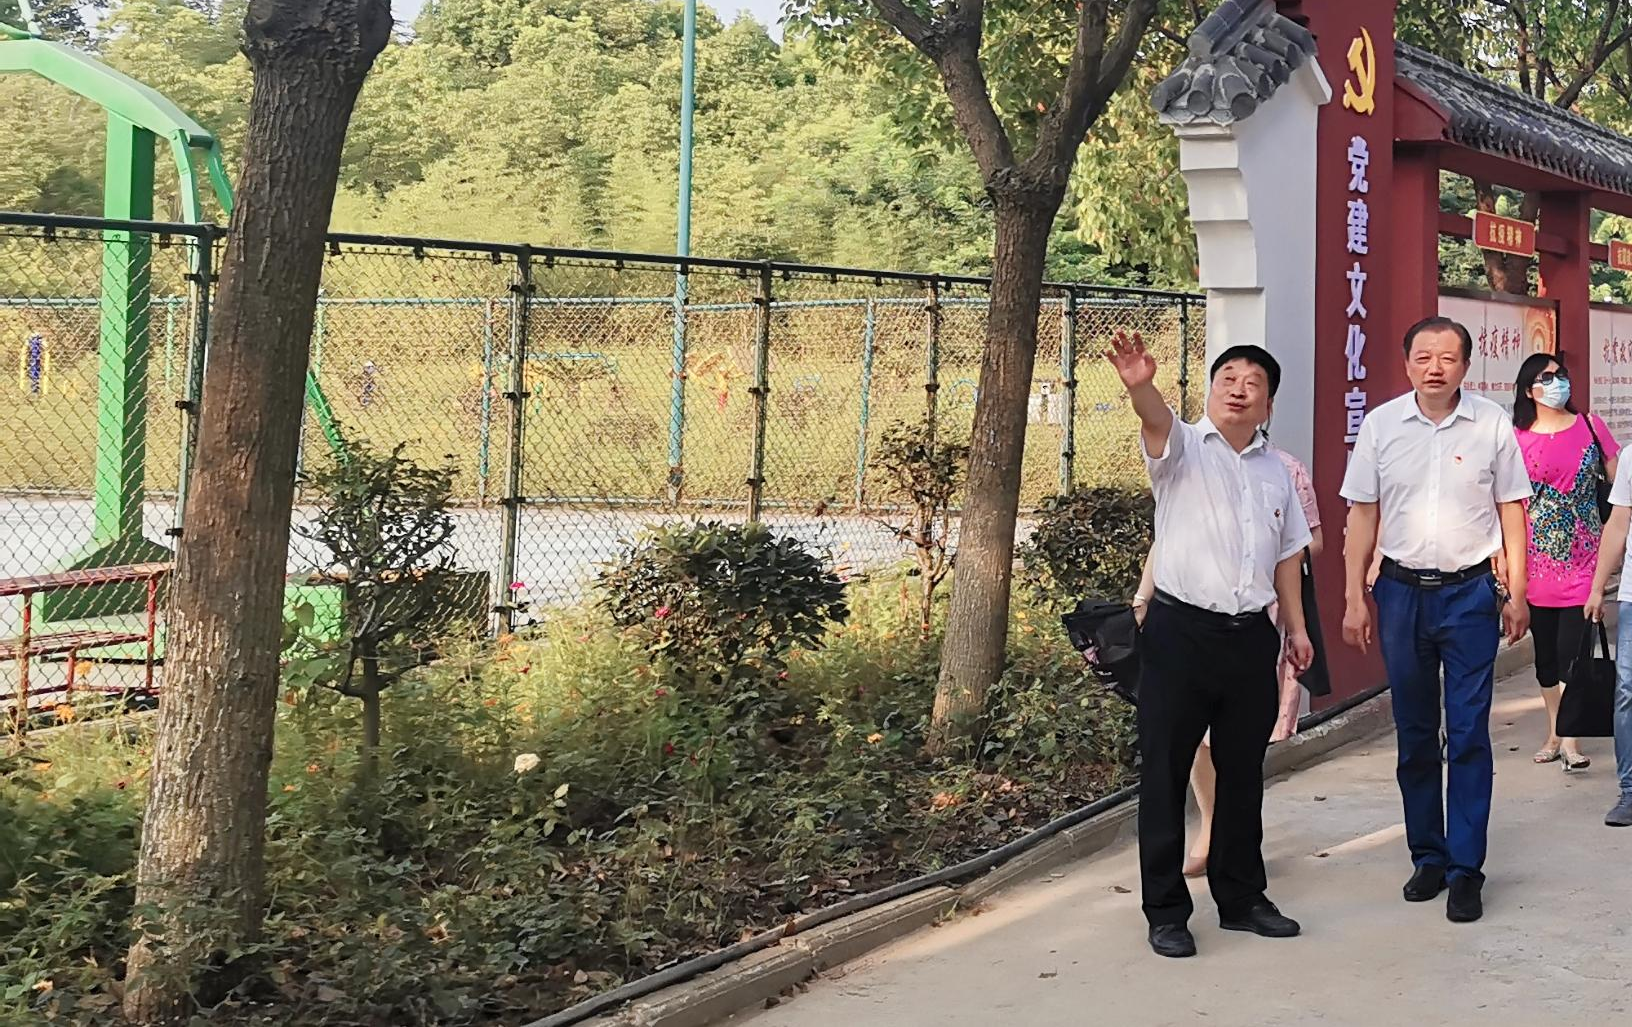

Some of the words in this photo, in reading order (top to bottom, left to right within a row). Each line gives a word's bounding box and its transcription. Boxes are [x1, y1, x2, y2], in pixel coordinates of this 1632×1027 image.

[1344, 136, 1370, 556] 党建文化宣
[1478, 325, 1521, 360] 抗疫精神
